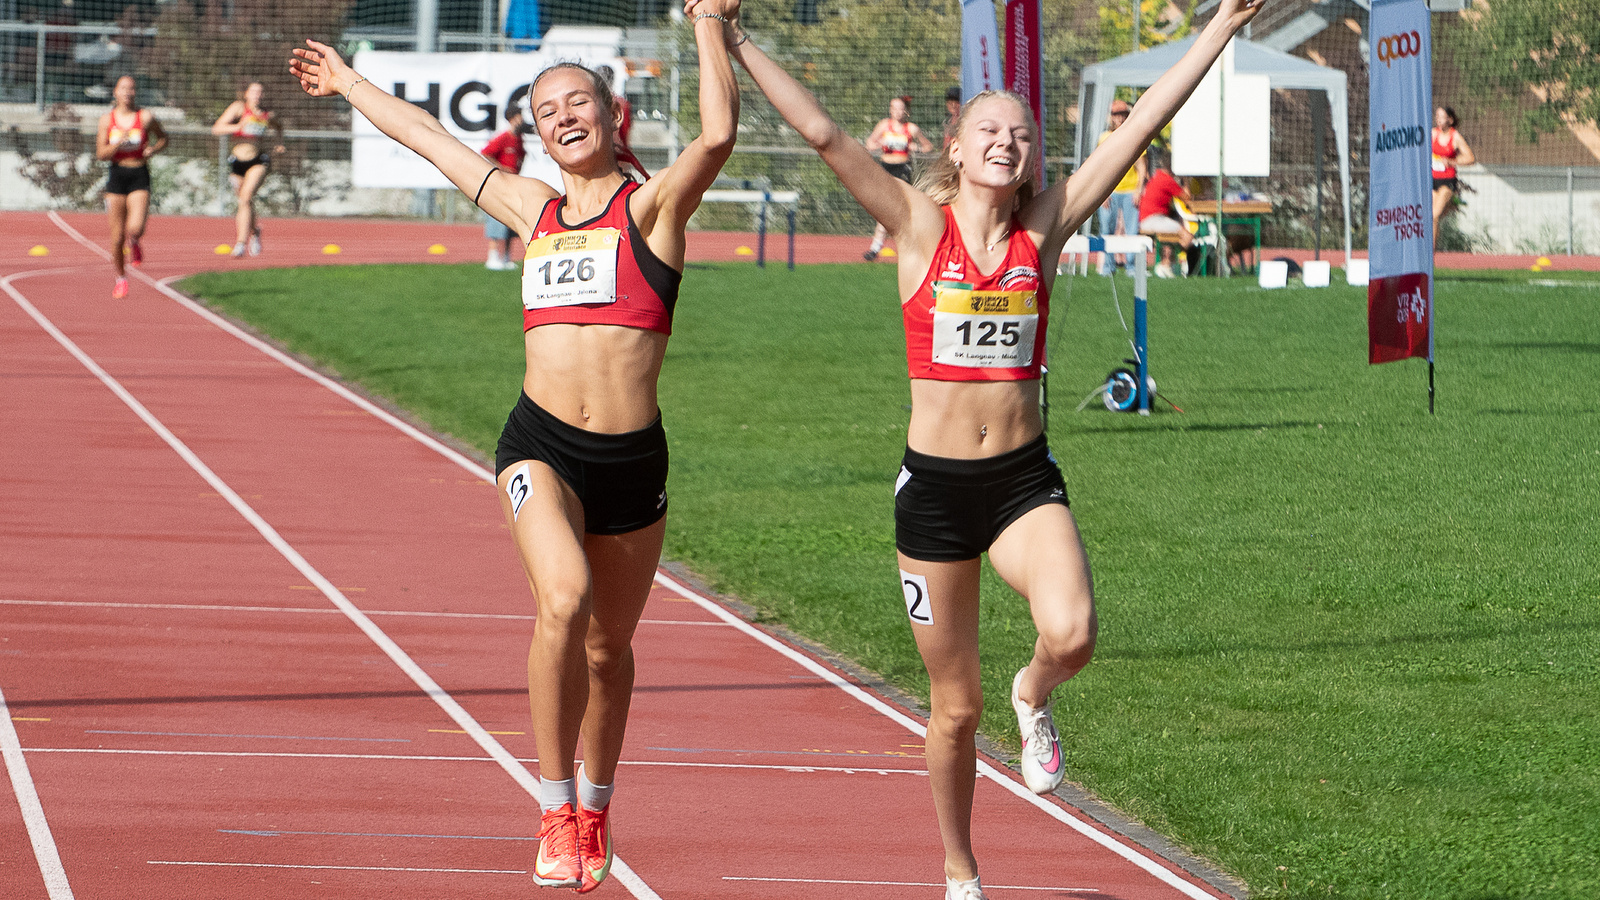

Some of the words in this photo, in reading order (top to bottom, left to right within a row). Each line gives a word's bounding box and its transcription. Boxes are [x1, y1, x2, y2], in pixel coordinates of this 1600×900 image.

[538, 257, 595, 286] 126
[996, 296, 1009, 307] 25
[956, 320, 1020, 347] 125
[511, 473, 528, 514] 3
[904, 579, 930, 621] 2
